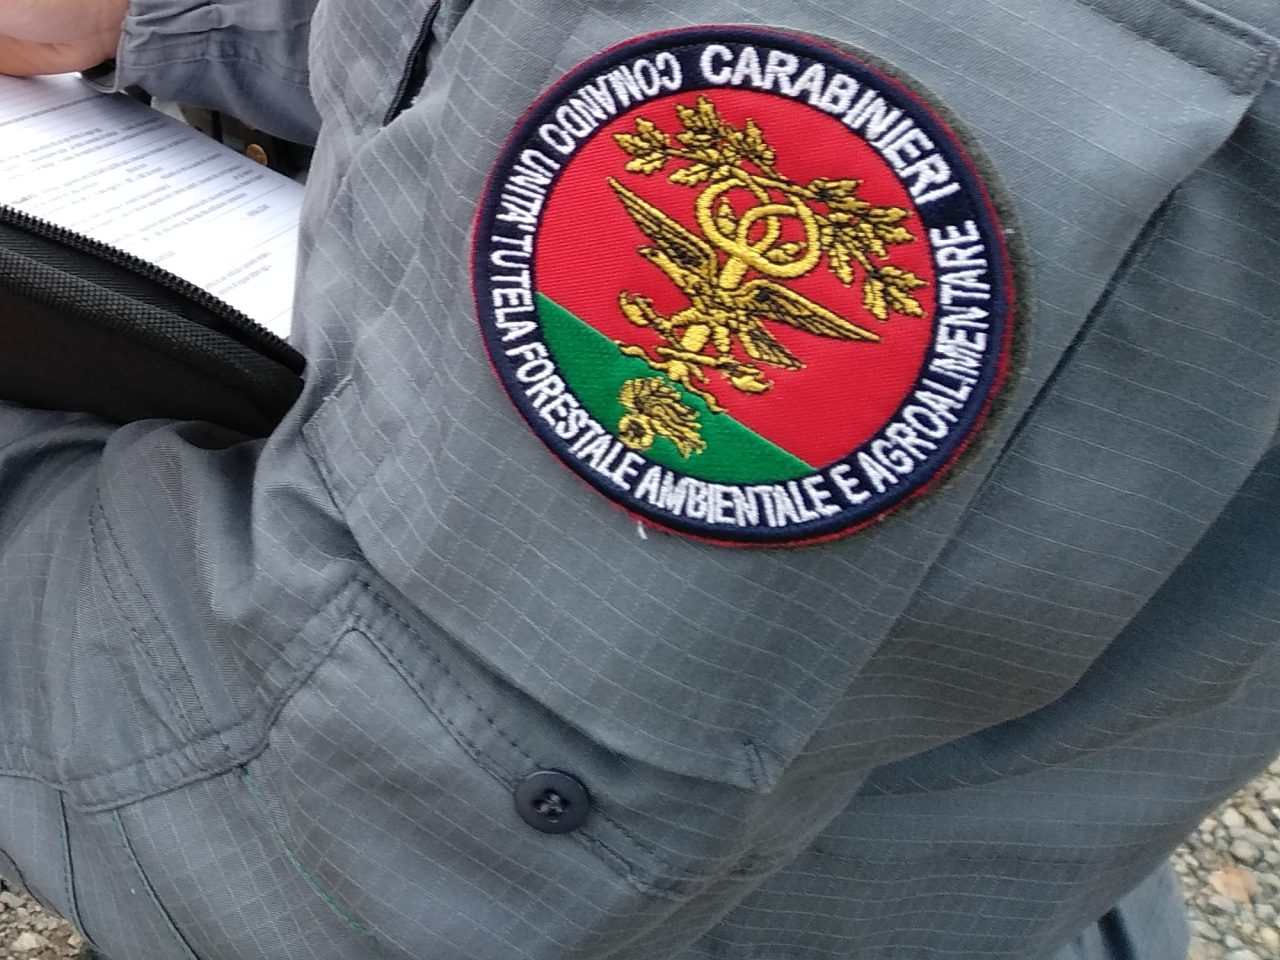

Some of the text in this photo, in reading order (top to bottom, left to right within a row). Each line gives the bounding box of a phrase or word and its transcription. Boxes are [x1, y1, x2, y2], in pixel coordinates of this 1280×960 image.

[538, 52, 682, 155] COMANDO
[699, 44, 962, 205] CARABINIERI
[490, 235, 538, 342] TUTELA
[857, 220, 991, 494] AGROALIMENTARE
[505, 342, 647, 490] FORESTALE
[634, 466, 842, 527] AMBIENTALE
[829, 464, 872, 505] E
